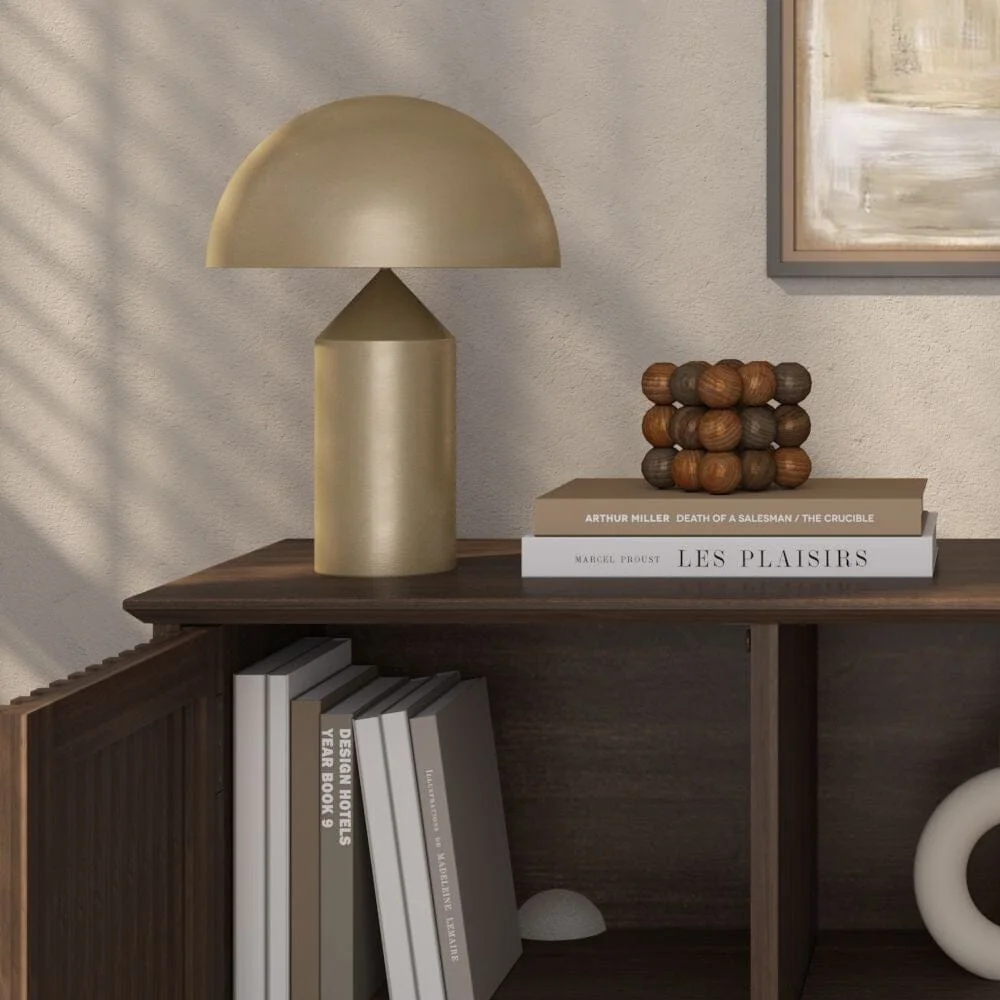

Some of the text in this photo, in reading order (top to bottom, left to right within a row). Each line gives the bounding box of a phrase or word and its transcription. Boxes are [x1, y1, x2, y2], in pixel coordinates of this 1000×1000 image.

[584, 513, 629, 523] ARTHUR
[631, 513, 670, 523] MILLER
[676, 513, 710, 523] DEATH
[712, 513, 727, 523] OF
[728, 513, 737, 523] A
[738, 513, 793, 523] SALESMAN
[801, 513, 822, 523] THE
[823, 513, 875, 523] CRUCIBLE
[574, 555, 661, 564] MARCEL PROUST
[678, 549, 869, 568] LES PLAISIRS
[321, 728, 334, 828] YEAR BOOK 9
[338, 728, 352, 847] DESIGN HOTELS
[437, 852, 452, 911] MADELEINE
[446, 917, 460, 962] LEMAIRE
